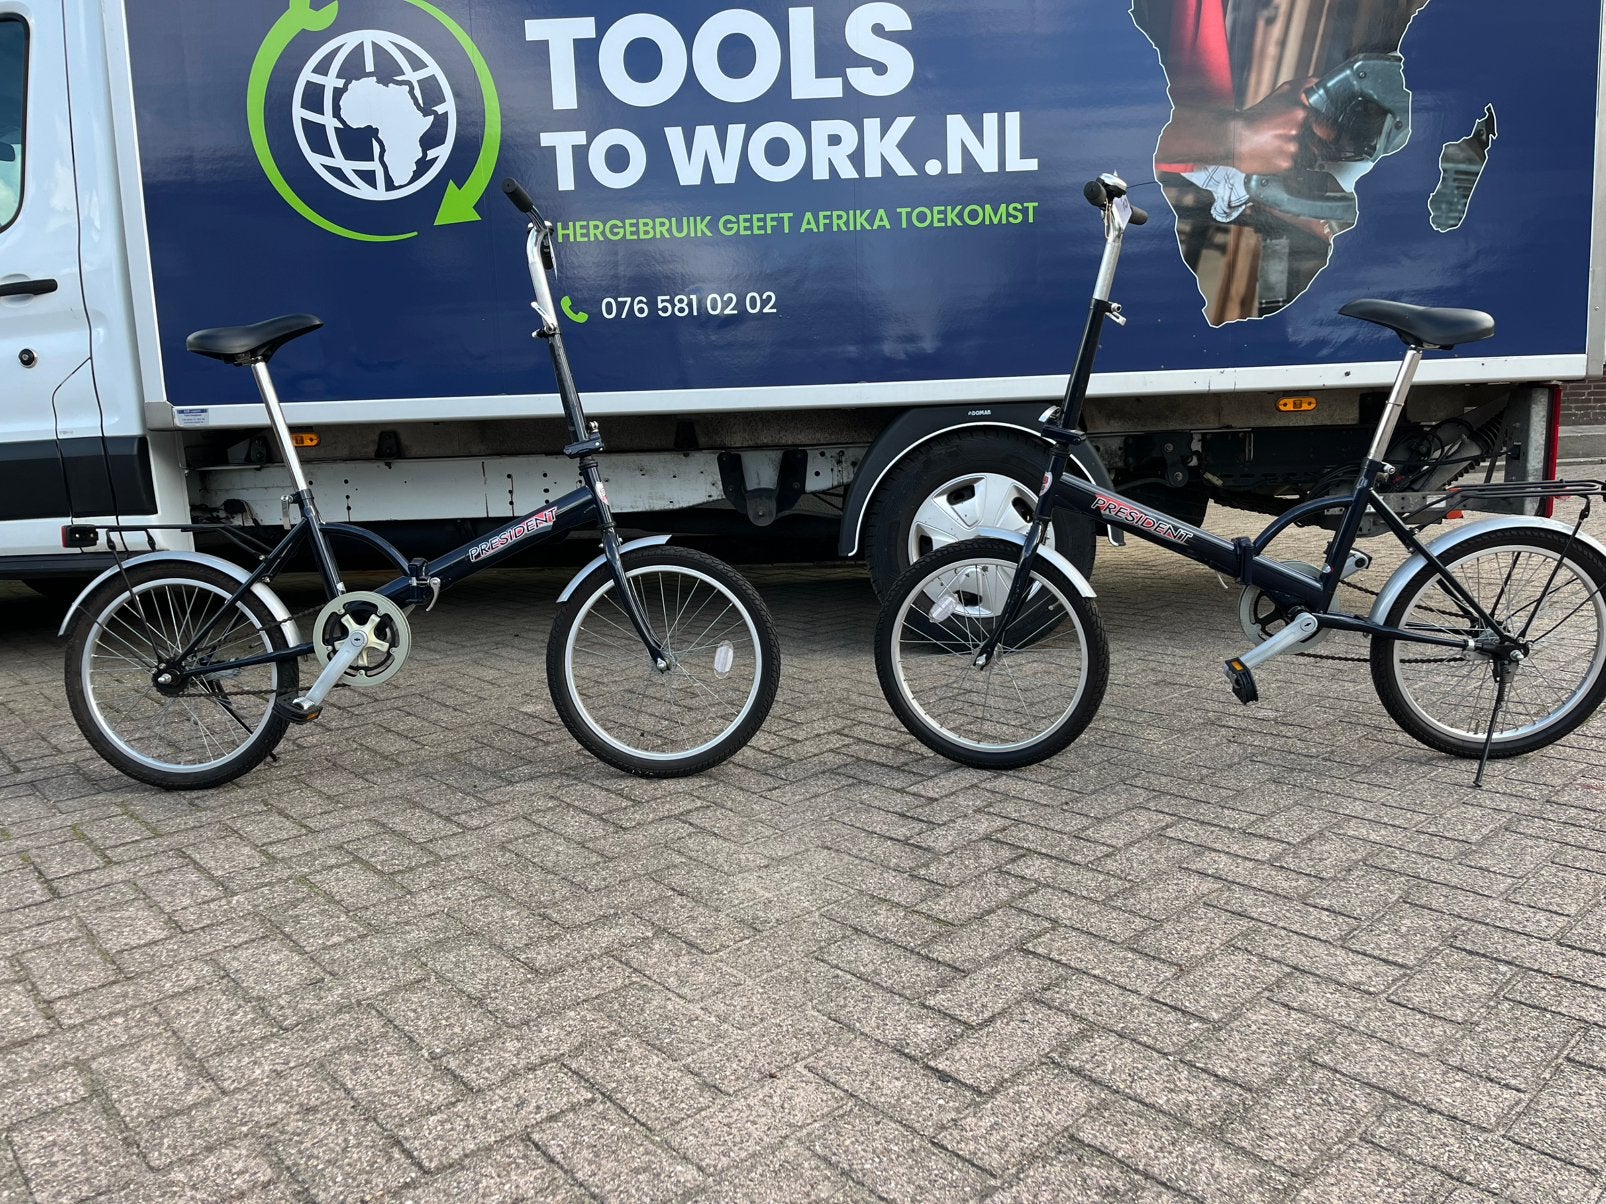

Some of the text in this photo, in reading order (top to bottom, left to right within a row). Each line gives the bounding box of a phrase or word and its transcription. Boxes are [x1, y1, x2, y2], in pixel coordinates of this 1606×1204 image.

[524, 2, 915, 110] TOOLS
[540, 111, 1039, 191] TO WORK.NL
[556, 202, 1039, 243] HERGEBRUIK GEEFT AFRIKA TOEKOMST
[601, 291, 778, 319] 076 581 02 02
[468, 506, 558, 562] PRESIDENT
[1091, 497, 1193, 543] PRESIDENT
